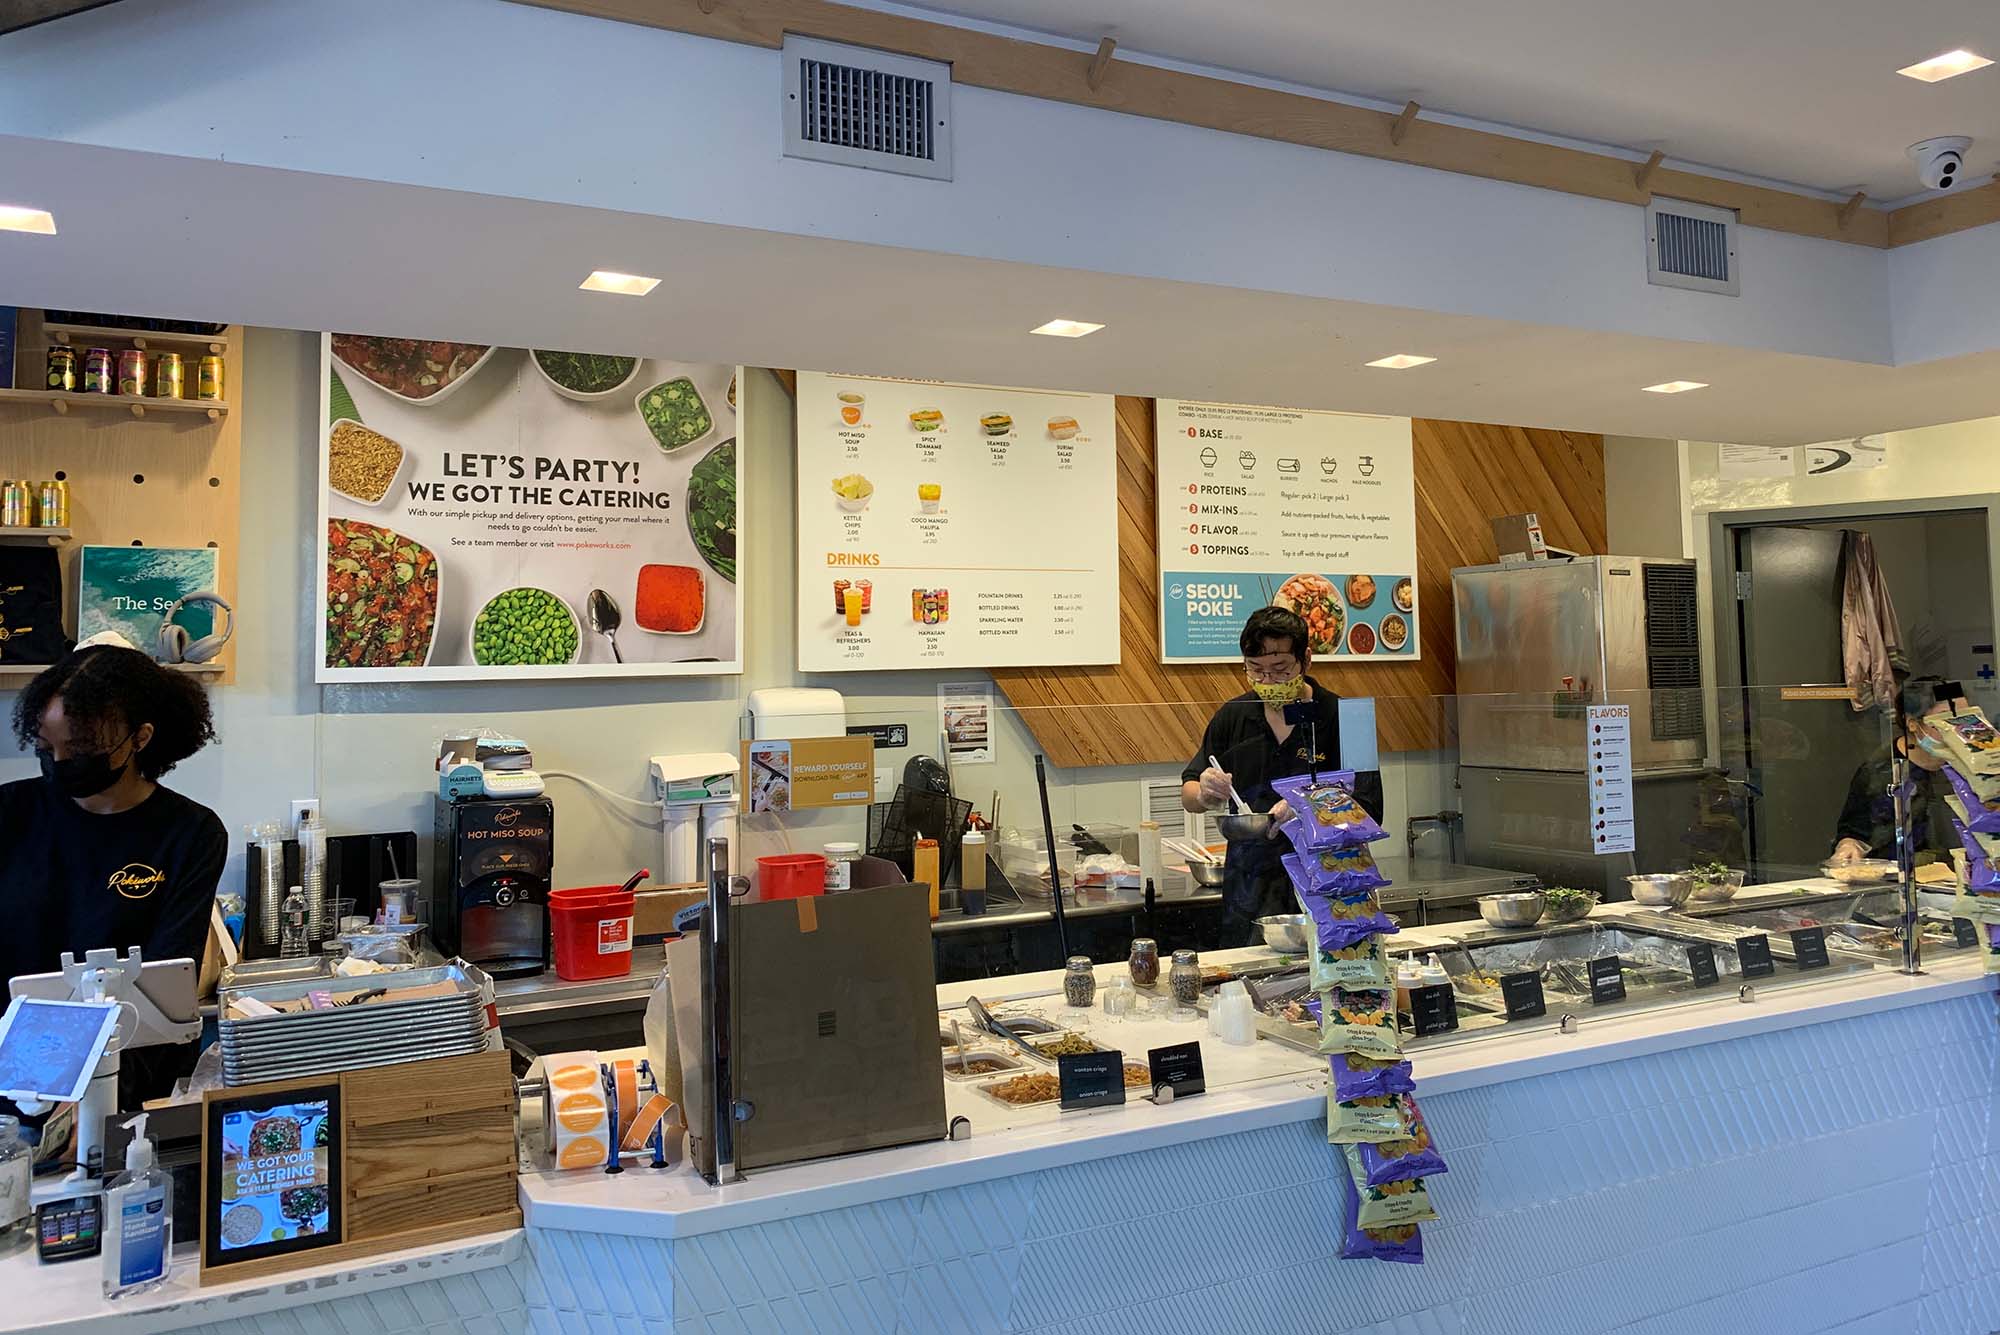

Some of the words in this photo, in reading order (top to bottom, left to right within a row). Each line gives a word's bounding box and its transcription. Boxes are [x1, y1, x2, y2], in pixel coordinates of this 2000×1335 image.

[1199, 428, 1223, 439] BASE
[535, 457, 640, 484] PARTY!
[408, 482, 445, 501] WE
[452, 484, 503, 503] GOT
[508, 486, 552, 505] THE
[559, 488, 670, 509] CATERING
[1200, 485, 1247, 496] PROTEINS
[408, 508, 427, 517] With
[445, 509, 470, 520] simple
[472, 510, 497, 521] pickup
[499, 511, 513, 519] and
[515, 511, 544, 521] delivery
[546, 512, 576, 523] options,
[577, 514, 603, 524] getting
[604, 516, 621, 524] your
[623, 515, 640, 523] meal
[641, 516, 663, 524] where
[664, 516, 670, 524] it
[1201, 505, 1238, 515] MIX-INS
[521, 525, 531, 533] go
[532, 524, 562, 532] couldn't
[575, 525, 598, 533] easier.
[1201, 525, 1238, 535] FLAVOR
[451, 537, 466, 546] See
[496, 539, 527, 547] member
[556, 541, 631, 550] www.pokeworks.com
[1202, 545, 1249, 556] TOPPINGS
[1281, 549, 1291, 558] Top
[827, 552, 880, 566] DRINKS
[1186, 583, 1243, 599] SEOUL
[112, 596, 147, 610] The
[153, 597, 184, 611] Se
[1186, 600, 1233, 617] POKE
[1589, 707, 1629, 719] FLAVORS
[793, 764, 828, 773] REWARD
[829, 762, 868, 771] YOURSELF
[467, 830, 489, 839] HOT
[490, 829, 516, 839] MISO
[518, 828, 544, 838] SOUP
[236, 1160, 254, 1171] WE
[257, 1155, 280, 1169] GOT
[283, 1151, 315, 1164] YOUR
[236, 1164, 316, 1187] CATERING
[124, 1223, 146, 1231] Hand
[124, 1225, 160, 1238] Sanitizer
